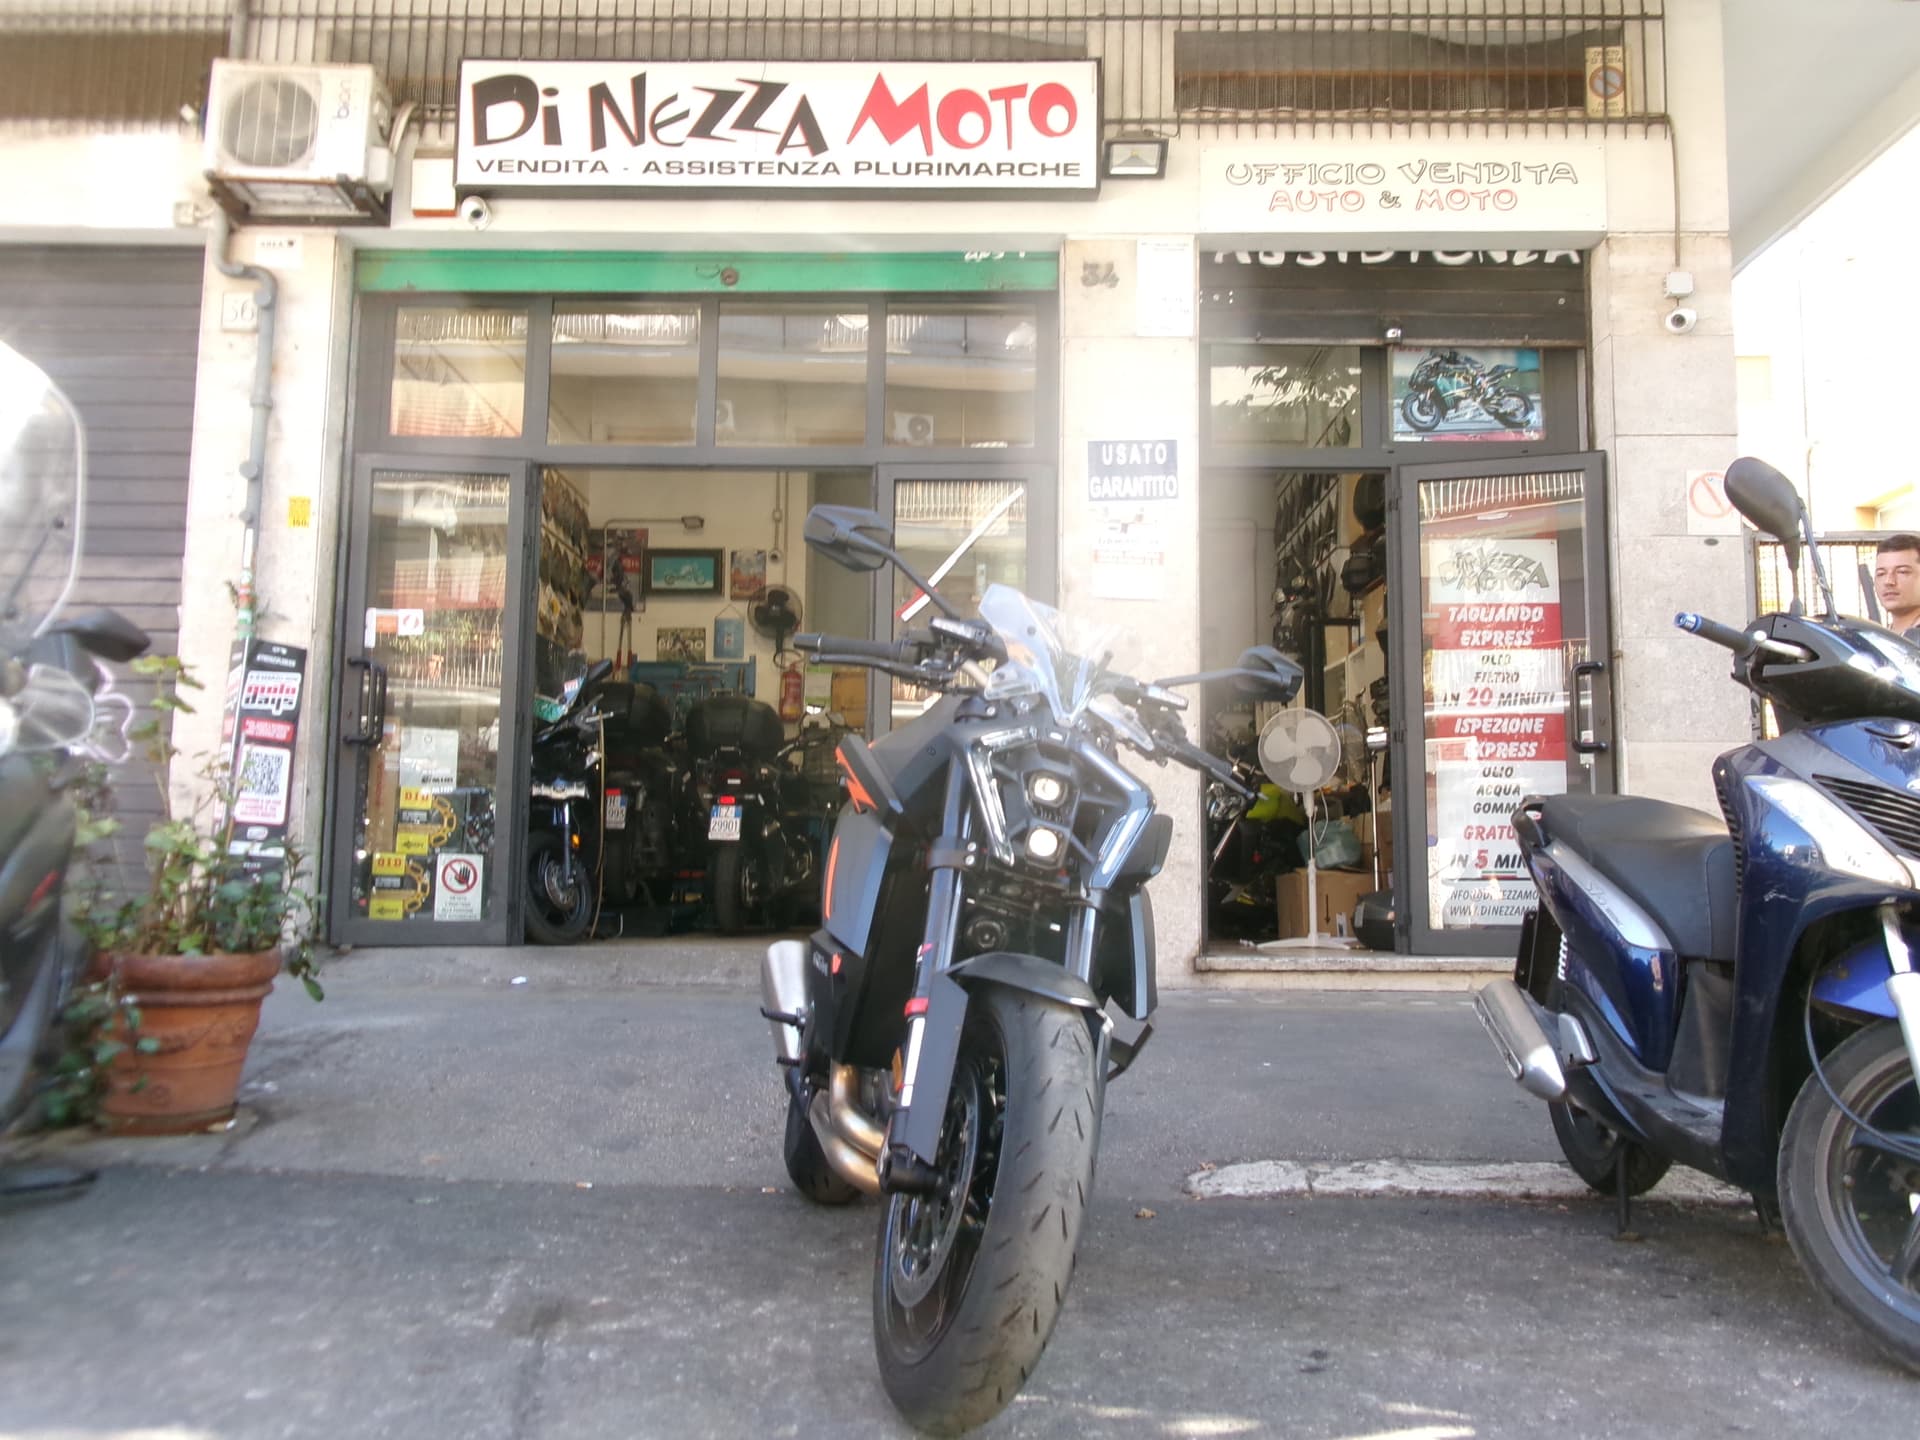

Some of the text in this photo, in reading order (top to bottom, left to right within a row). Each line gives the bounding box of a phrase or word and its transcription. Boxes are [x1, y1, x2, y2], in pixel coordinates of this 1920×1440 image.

[846, 72, 1078, 157] MOTO
[476, 158, 610, 174] VENDITA
[642, 160, 841, 177] ASSISTENZA
[853, 161, 1081, 177] PLURIMARCHE
[1225, 161, 1580, 187] UFFICIO VENDITA
[1269, 189, 1519, 213] AUTO & MOTO
[1102, 443, 1168, 466] USATO
[1089, 475, 1179, 499] GARANTITO
[1448, 606, 1545, 622] TAGLIANDO
[1460, 629, 1535, 647] EXPRESS
[1442, 687, 1556, 707] IN 20 MINUTI
[1454, 717, 1545, 735] ISPEZIONE
[1476, 784, 1521, 796] ACQUA
[1473, 802, 1522, 814] GOMM
[1474, 849, 1489, 869] 5
